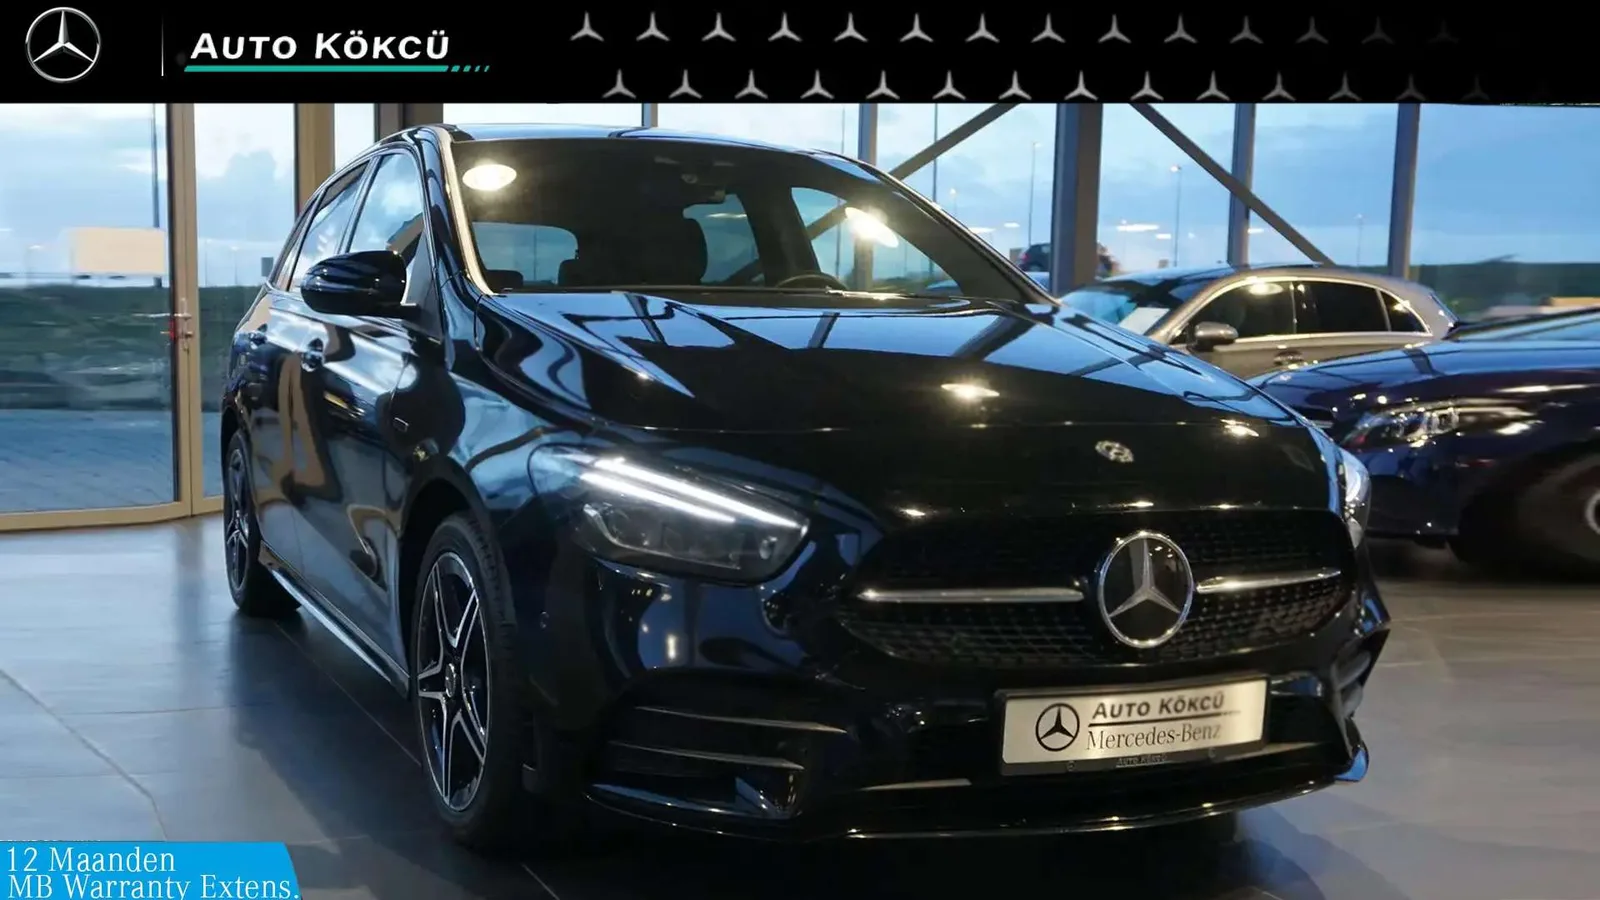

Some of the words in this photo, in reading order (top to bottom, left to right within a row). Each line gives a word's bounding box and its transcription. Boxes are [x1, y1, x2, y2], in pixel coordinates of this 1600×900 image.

[1092, 702, 1151, 719] AUTO
[1158, 692, 1226, 715] KÖKCÜ
[1087, 722, 1221, 750] Mercedes-Benz
